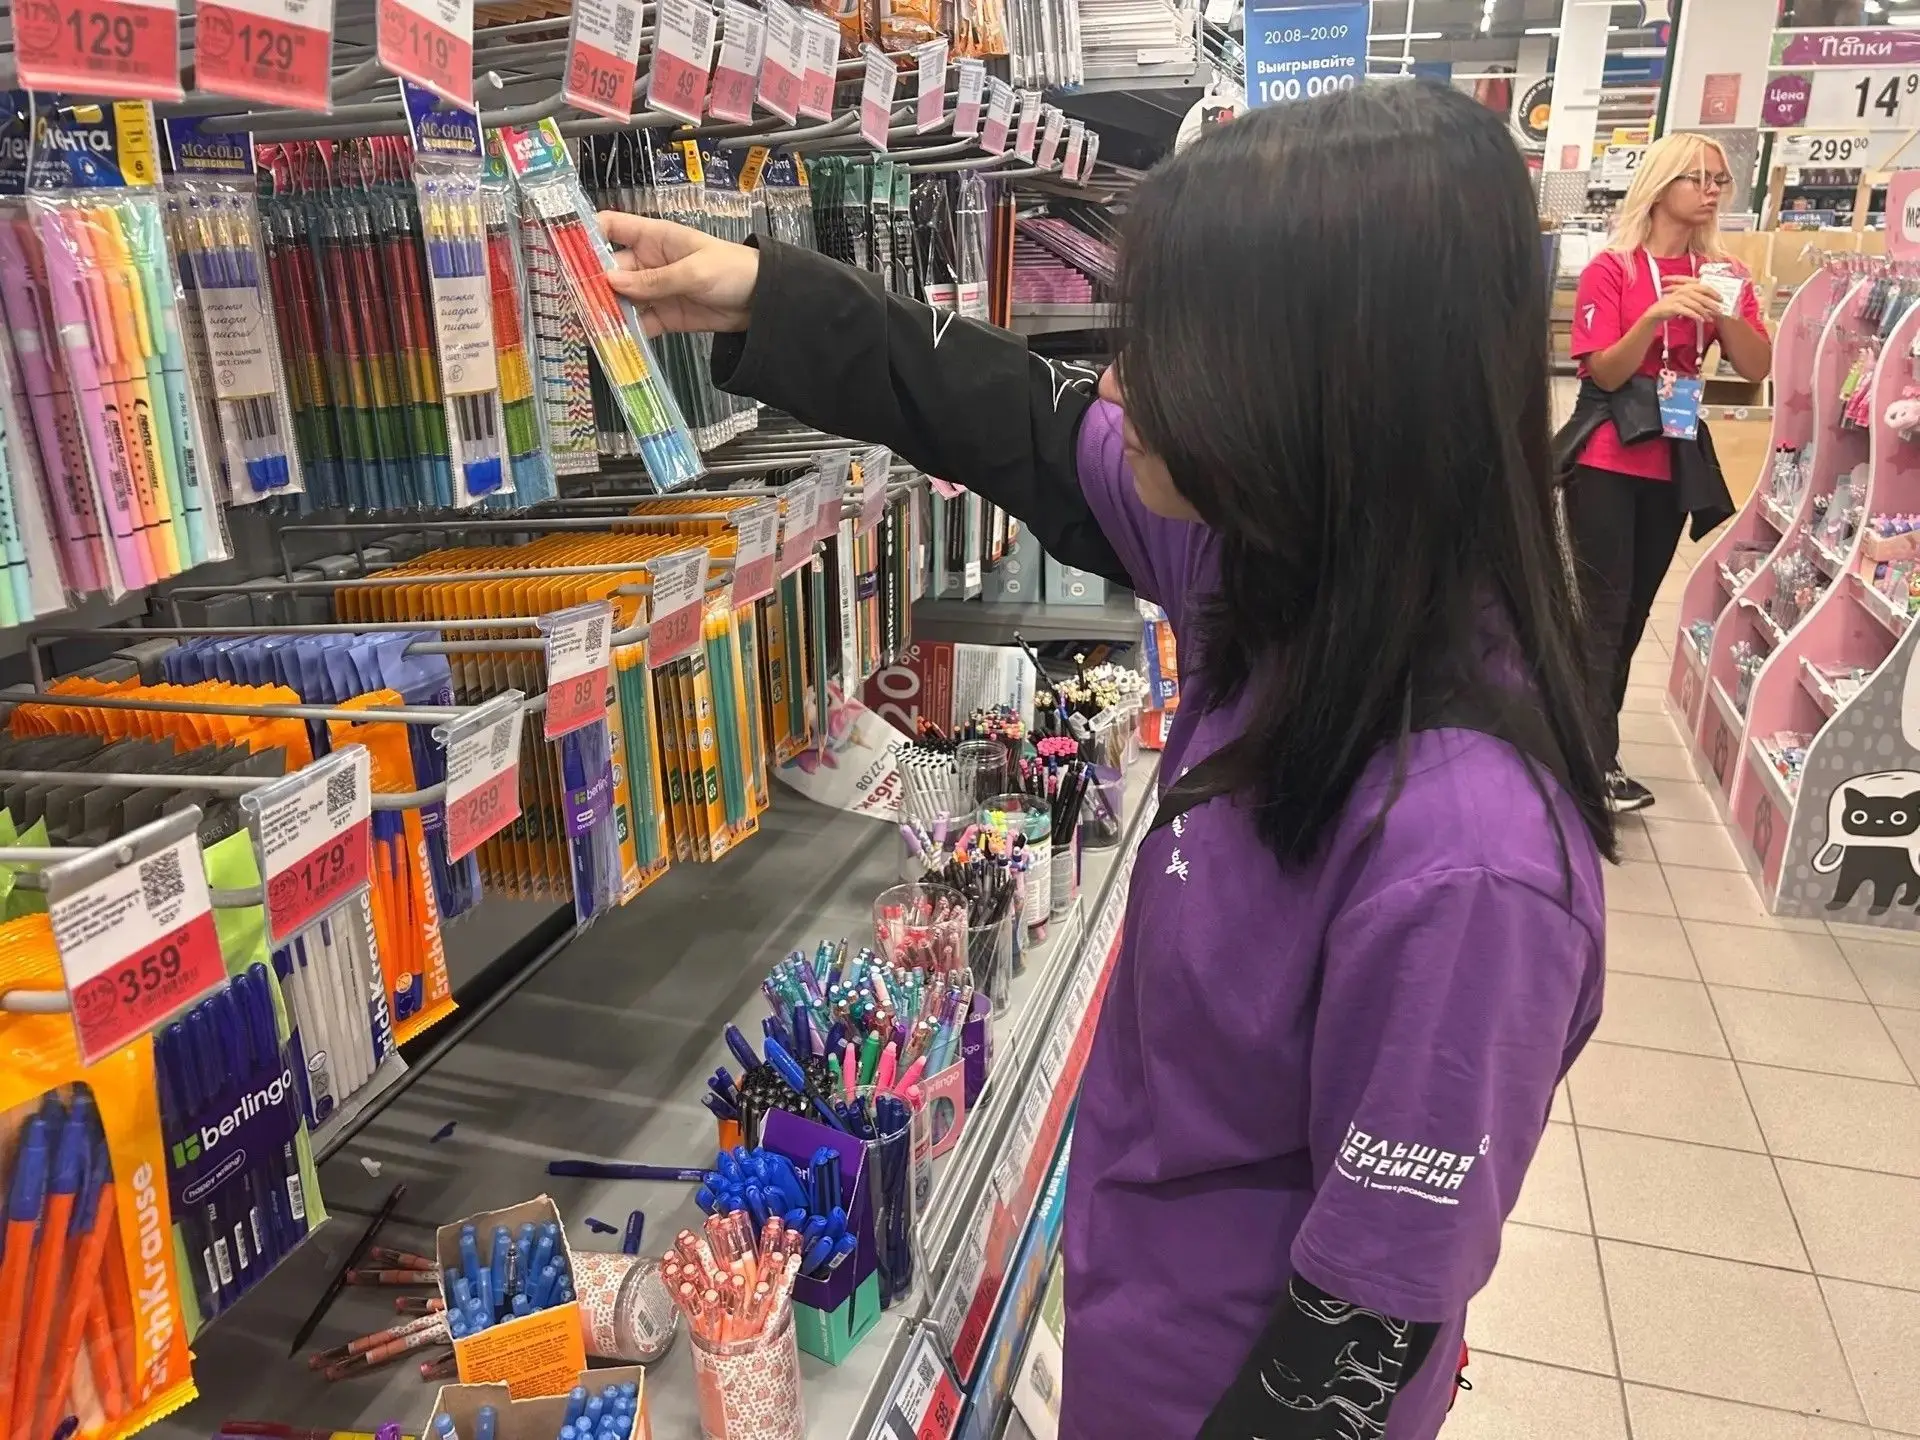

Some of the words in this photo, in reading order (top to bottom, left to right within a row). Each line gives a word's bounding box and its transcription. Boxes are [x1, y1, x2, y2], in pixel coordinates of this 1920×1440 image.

[67, 9, 135, 57] 129
[239, 24, 294, 70] 129
[408, 21, 450, 69] 119
[1820, 37, 1893, 57] Папки
[1257, 54, 1356, 75] Выигрывайте
[590, 68, 617, 99] 159
[1259, 78, 1300, 102] 100
[1771, 88, 1804, 102] Цена
[1855, 76, 1901, 117] 14
[1778, 104, 1793, 112] от
[135, 160, 144, 171] 6
[1809, 139, 1853, 161] 299
[665, 612, 689, 641] 319
[574, 679, 593, 706] 89
[468, 784, 499, 825] 269
[852, 769, 901, 811] шбэк,
[300, 842, 345, 892] 179
[417, 838, 450, 1001] ErichKrause
[118, 944, 181, 1005] 359
[200, 1068, 292, 1151] berlingo
[188, 1174, 216, 1198] happy
